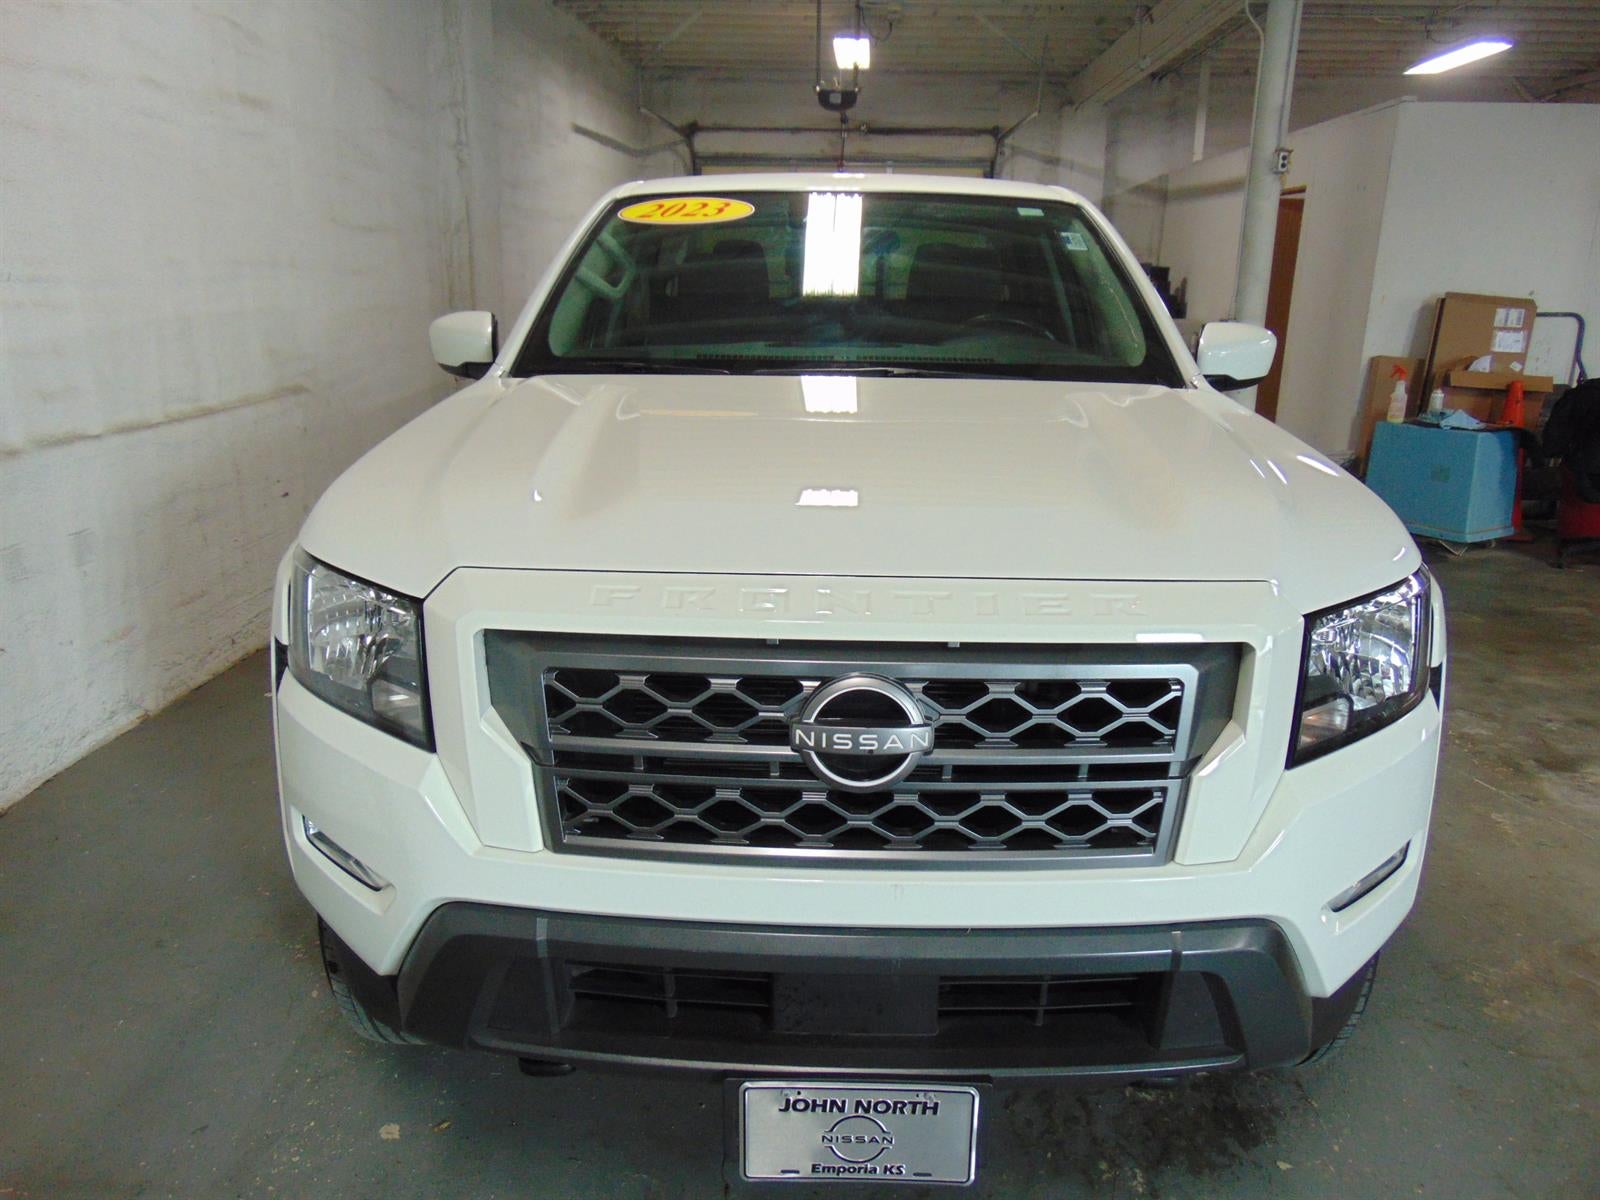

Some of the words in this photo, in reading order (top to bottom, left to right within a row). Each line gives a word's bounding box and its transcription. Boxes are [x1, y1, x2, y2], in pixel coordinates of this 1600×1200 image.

[635, 202, 731, 218] 2023
[591, 583, 1145, 616] FRONTIER
[795, 728, 929, 750] NISSAN
[779, 1098, 847, 1113] JOHN
[854, 1100, 939, 1115] NORTH
[822, 1134, 894, 1145] NISSAN
[811, 1164, 878, 1176] Emporia
[883, 1165, 905, 1175] KS
